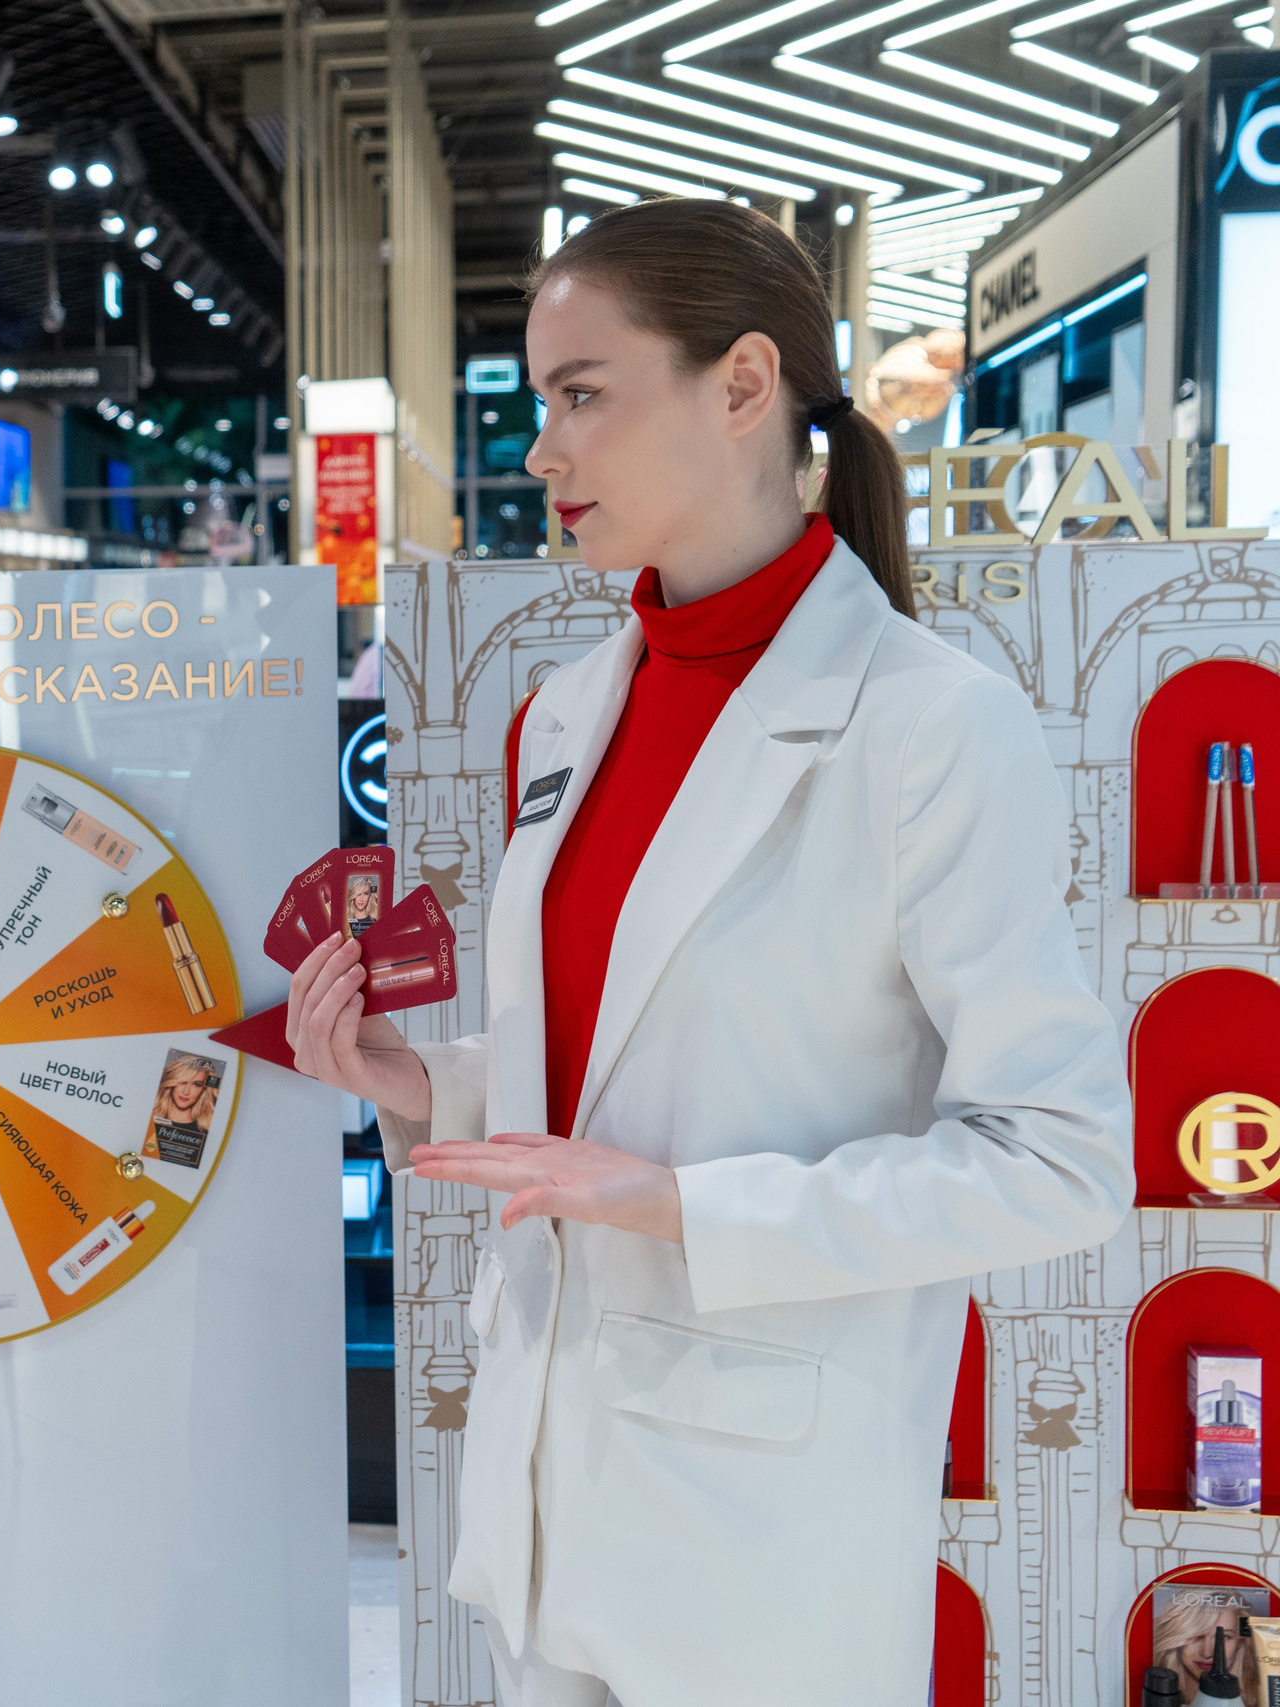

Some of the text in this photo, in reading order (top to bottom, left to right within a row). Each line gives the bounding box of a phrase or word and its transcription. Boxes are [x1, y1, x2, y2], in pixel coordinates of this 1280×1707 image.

[979, 248, 1042, 331] CHANEL
[15, 914, 42, 946] ТОН
[34, 966, 117, 1007] РОСКОШЬ
[51, 986, 114, 1019] И УХОД
[46, 1060, 107, 1086] НОВЫЙ
[20, 1073, 124, 1109] ЦВЕТ ВОЛОС
[52, 1181, 89, 1226] КОЖА
[1202, 1427, 1252, 1437] REVITALIFT
[1173, 1592, 1251, 1608] L'ORÉAL
